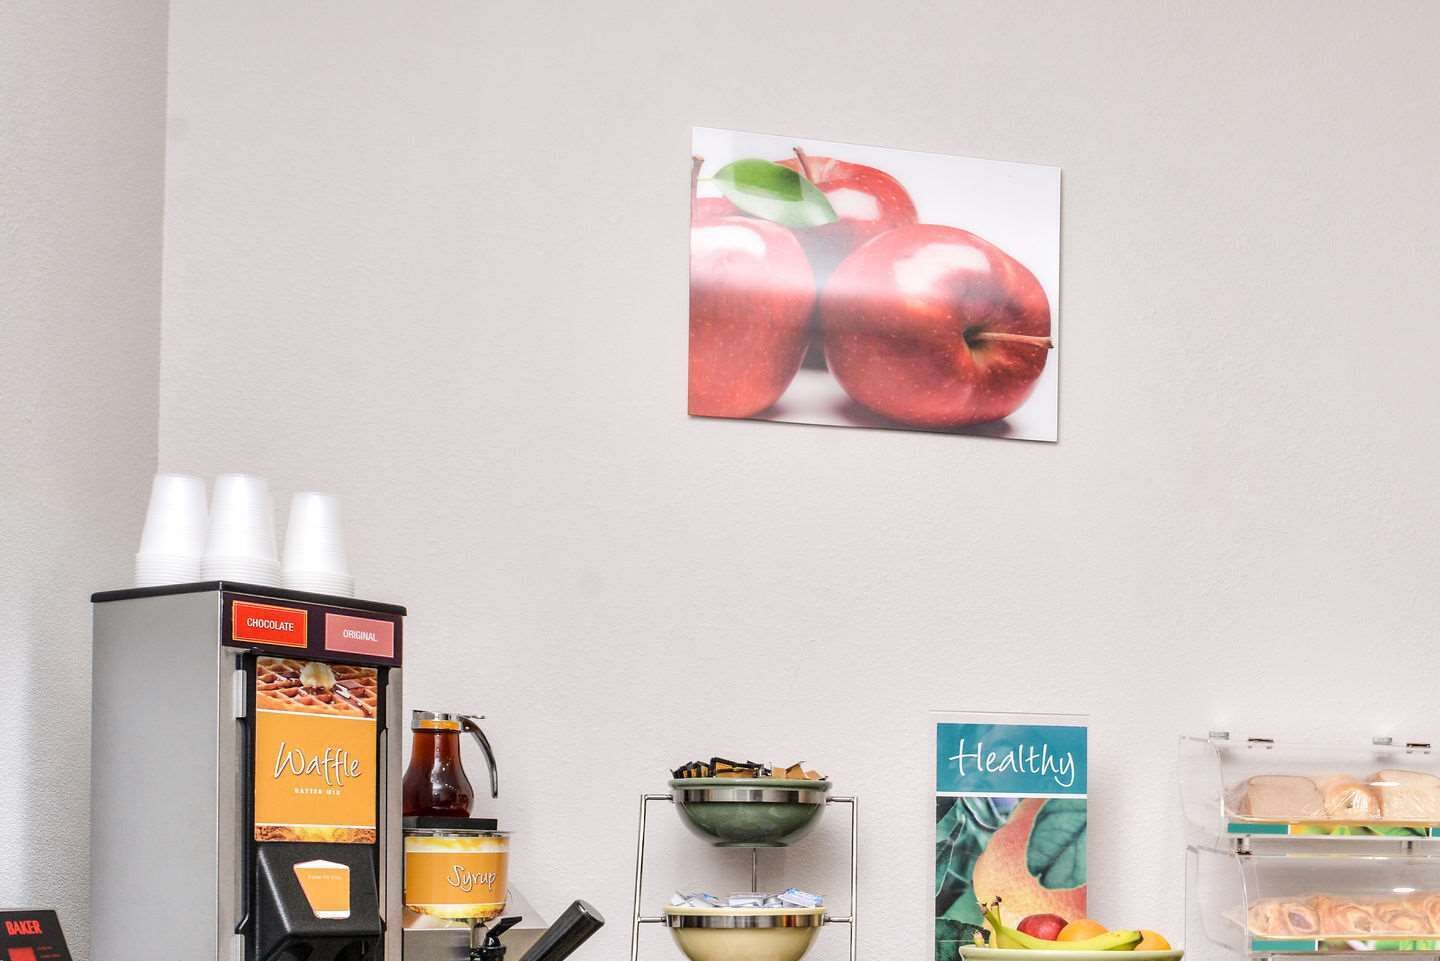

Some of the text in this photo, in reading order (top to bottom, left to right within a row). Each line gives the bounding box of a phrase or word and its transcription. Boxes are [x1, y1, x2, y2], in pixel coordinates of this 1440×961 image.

[246, 617, 294, 632] CHOCOLATE
[342, 629, 378, 642] ORIGINAL
[274, 742, 361, 787] Waffle
[949, 738, 1075, 788] Healthy
[448, 865, 496, 893] Syrup
[5, 920, 43, 936] BAKER
